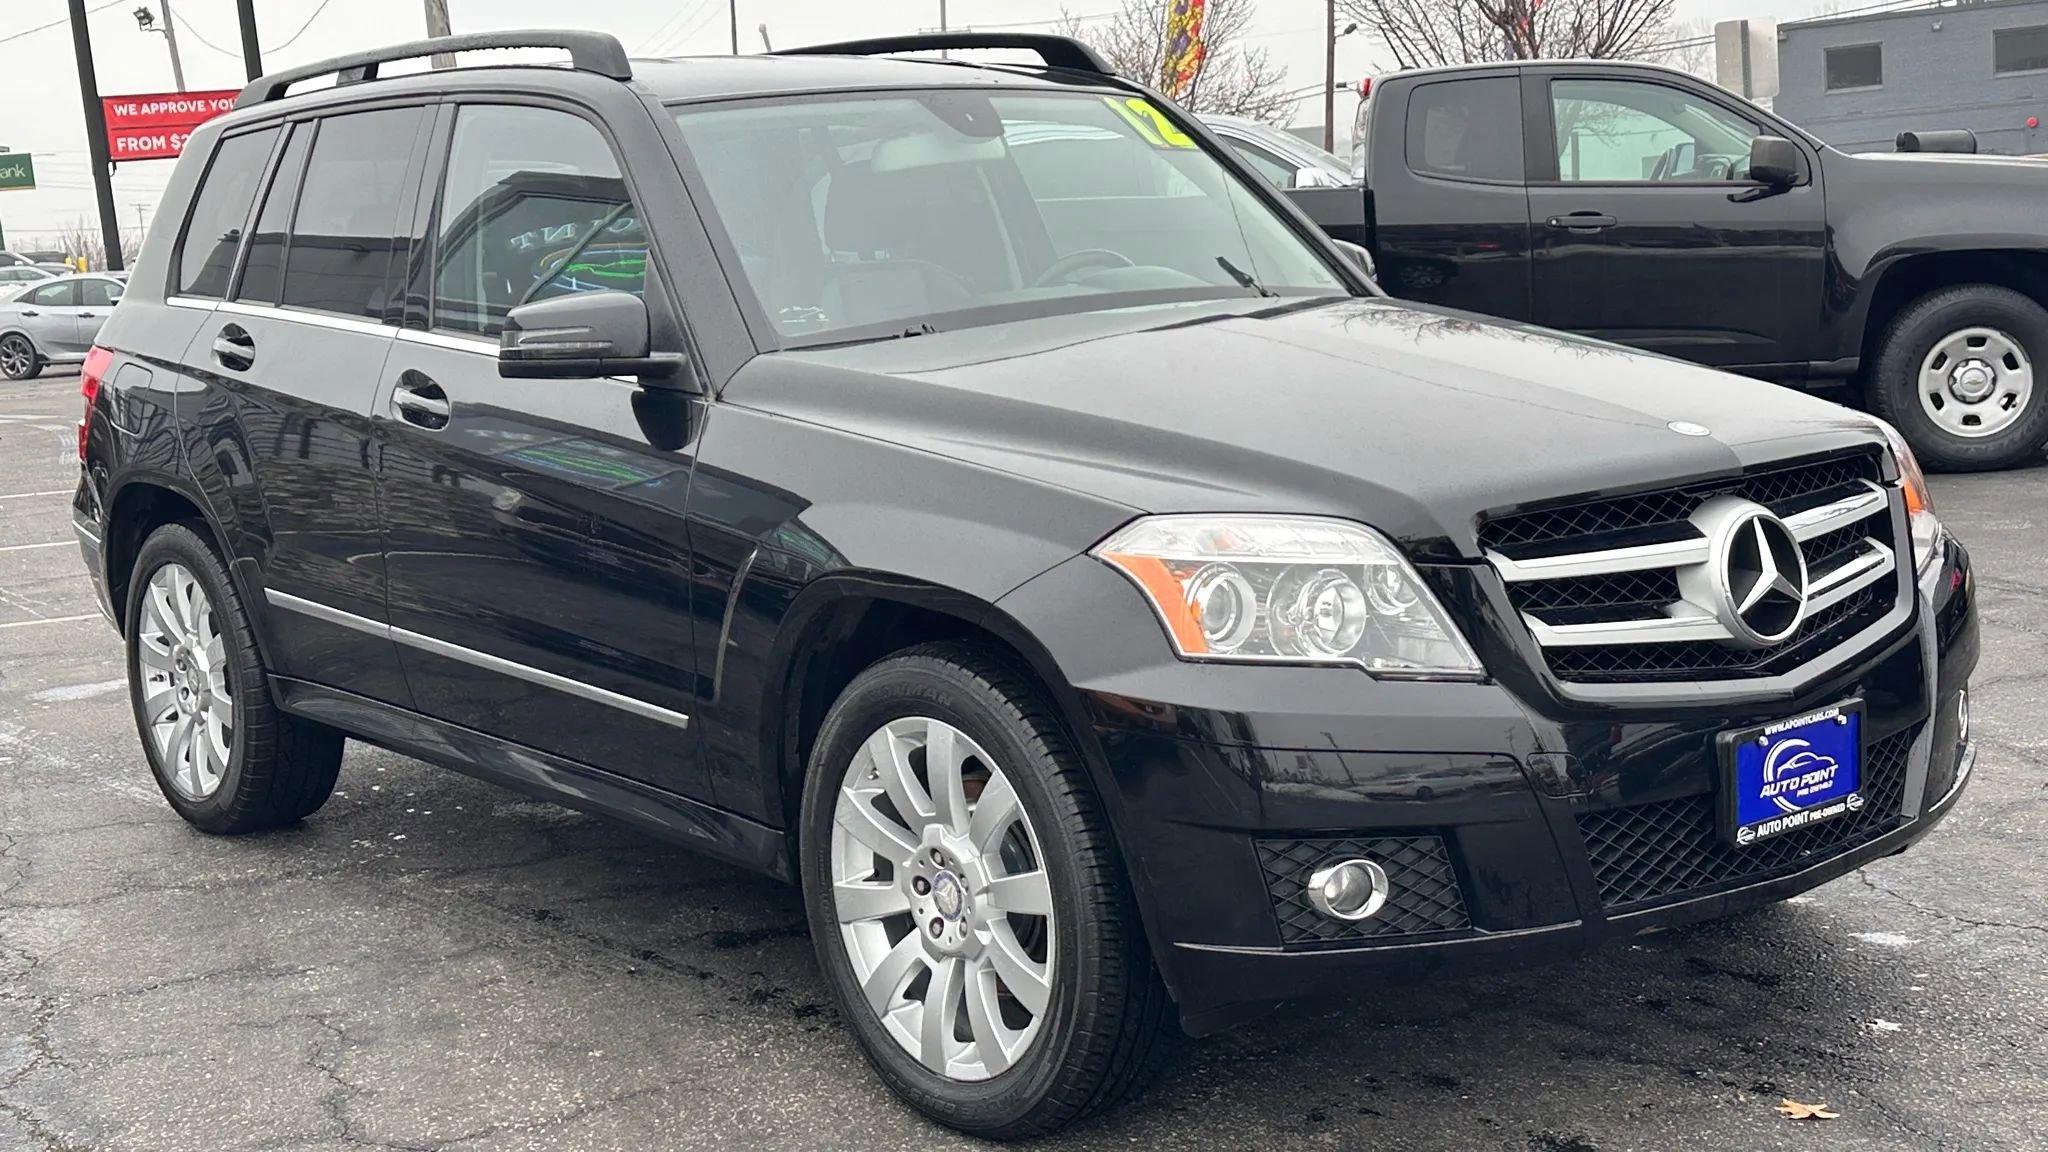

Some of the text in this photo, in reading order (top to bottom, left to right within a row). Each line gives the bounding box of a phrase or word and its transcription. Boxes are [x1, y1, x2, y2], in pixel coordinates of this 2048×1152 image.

[113, 103, 138, 116] WE
[141, 100, 206, 115] APPROVE
[1103, 96, 1199, 149] 12
[117, 135, 166, 152] FROM
[1764, 708, 1840, 736] WWW.APOINTCARS.COM
[1760, 764, 1839, 798] AUTO POINT
[1757, 819, 1781, 837] AUTO
[1782, 811, 1809, 830] POINT
[1810, 802, 1846, 821] PRE-OWNED
